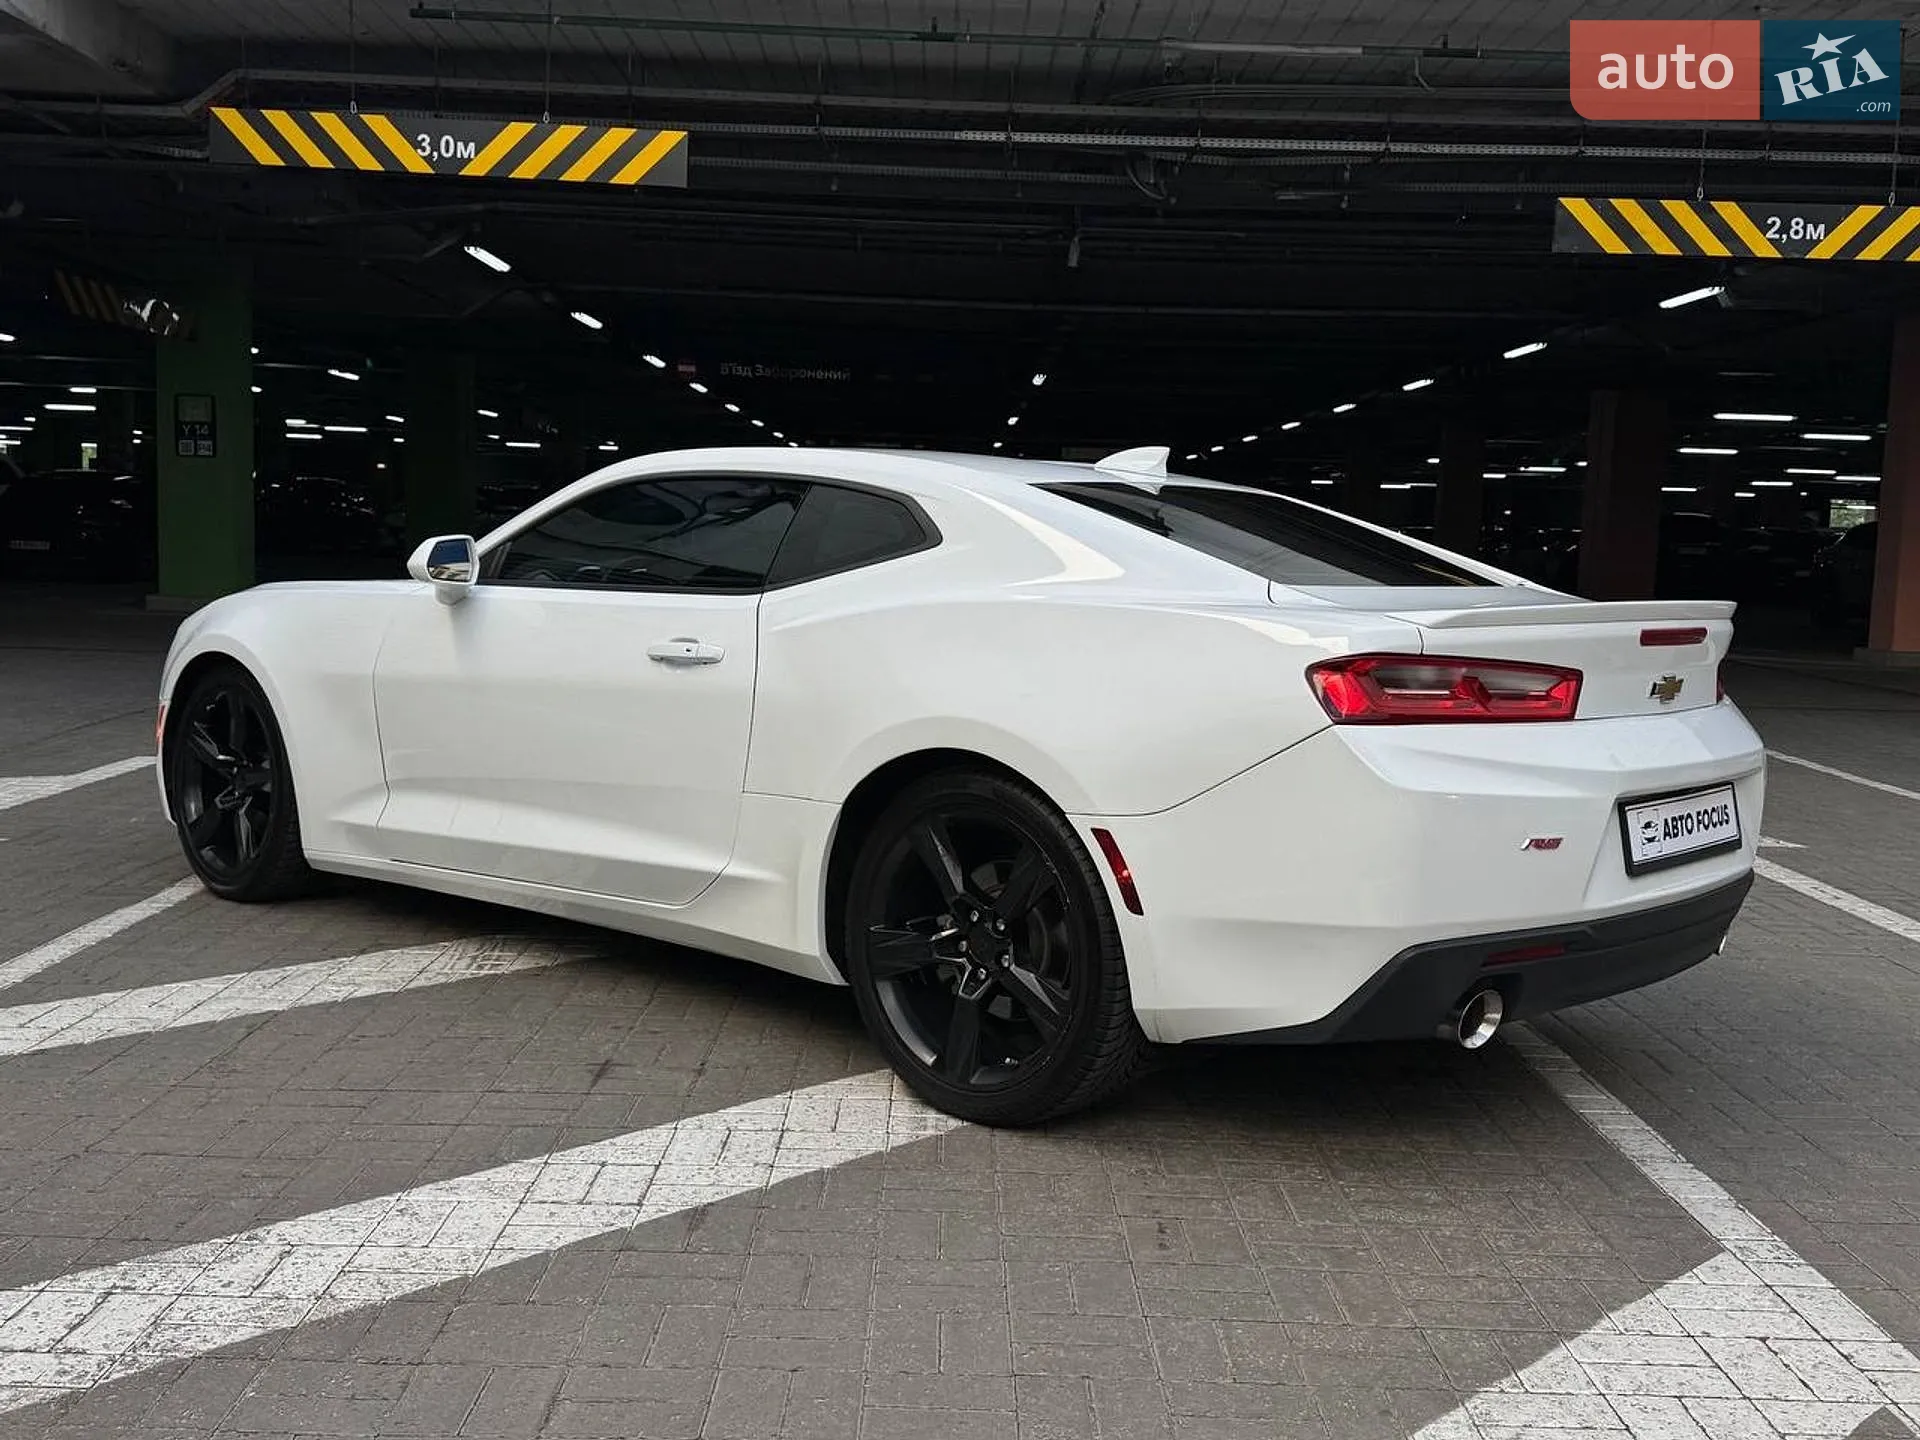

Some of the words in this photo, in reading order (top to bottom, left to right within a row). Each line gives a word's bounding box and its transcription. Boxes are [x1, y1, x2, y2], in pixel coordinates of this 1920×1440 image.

[416, 133, 476, 161] 3,0м
[1765, 216, 1825, 243] 2,8м
[1696, 804, 1730, 832] FOCUS
